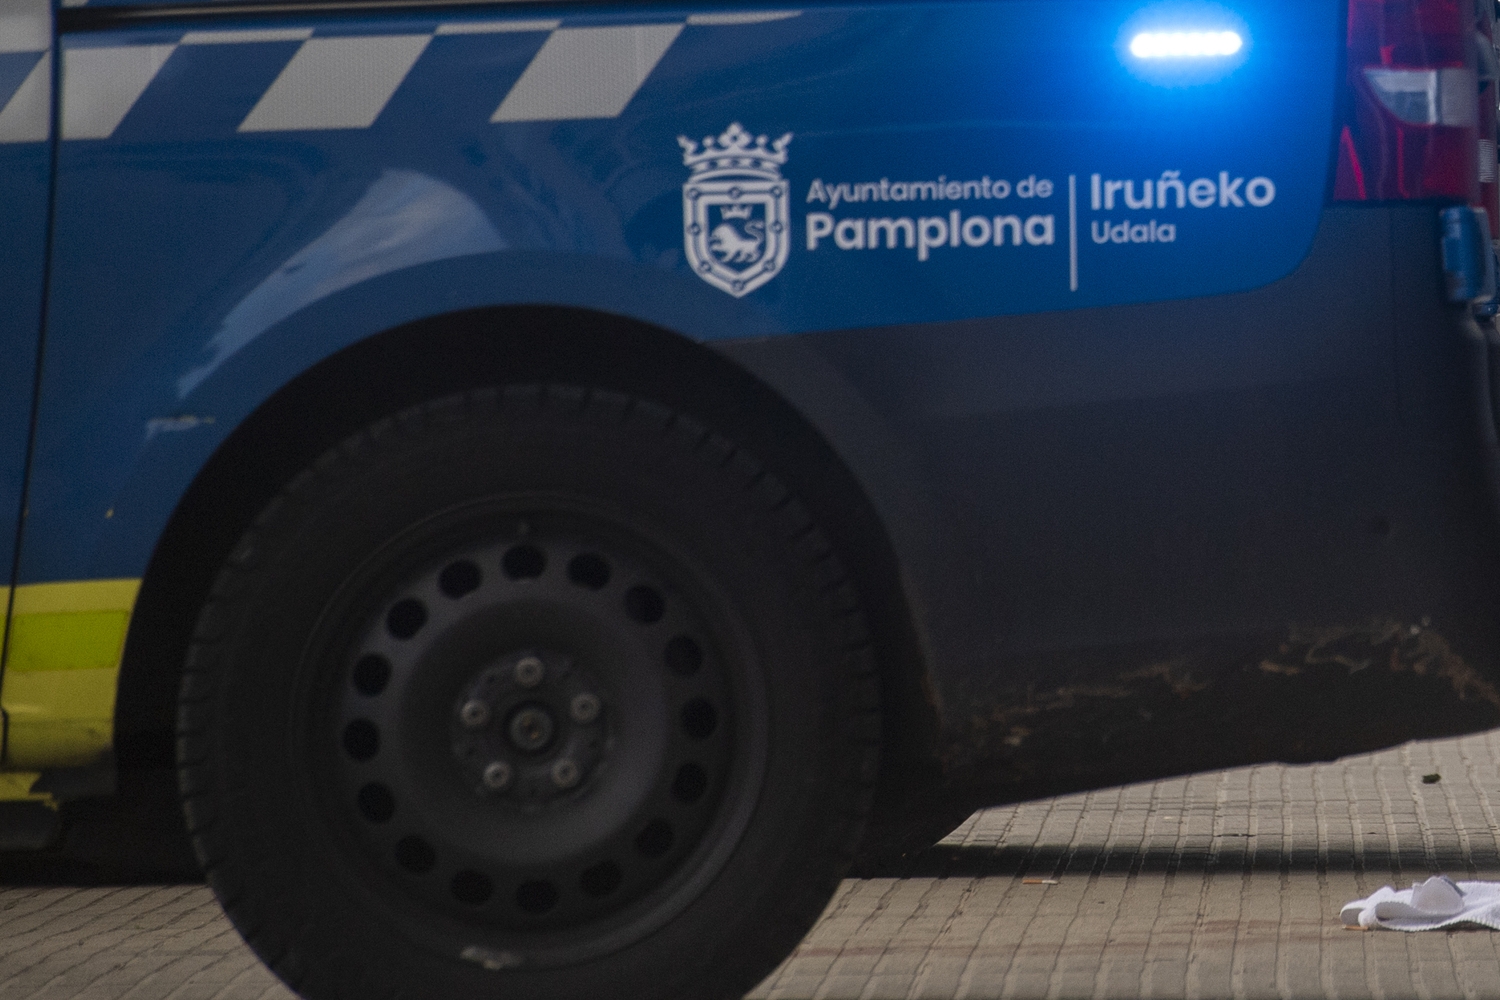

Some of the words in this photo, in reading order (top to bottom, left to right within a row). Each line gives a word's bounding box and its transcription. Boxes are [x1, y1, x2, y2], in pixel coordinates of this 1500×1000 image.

[806, 175, 1010, 210] Ayuntamiento
[1016, 174, 1054, 199] de
[1091, 170, 1276, 210] Iruñeko
[806, 209, 1055, 262] Pamplona
[1091, 219, 1176, 244] Udala
